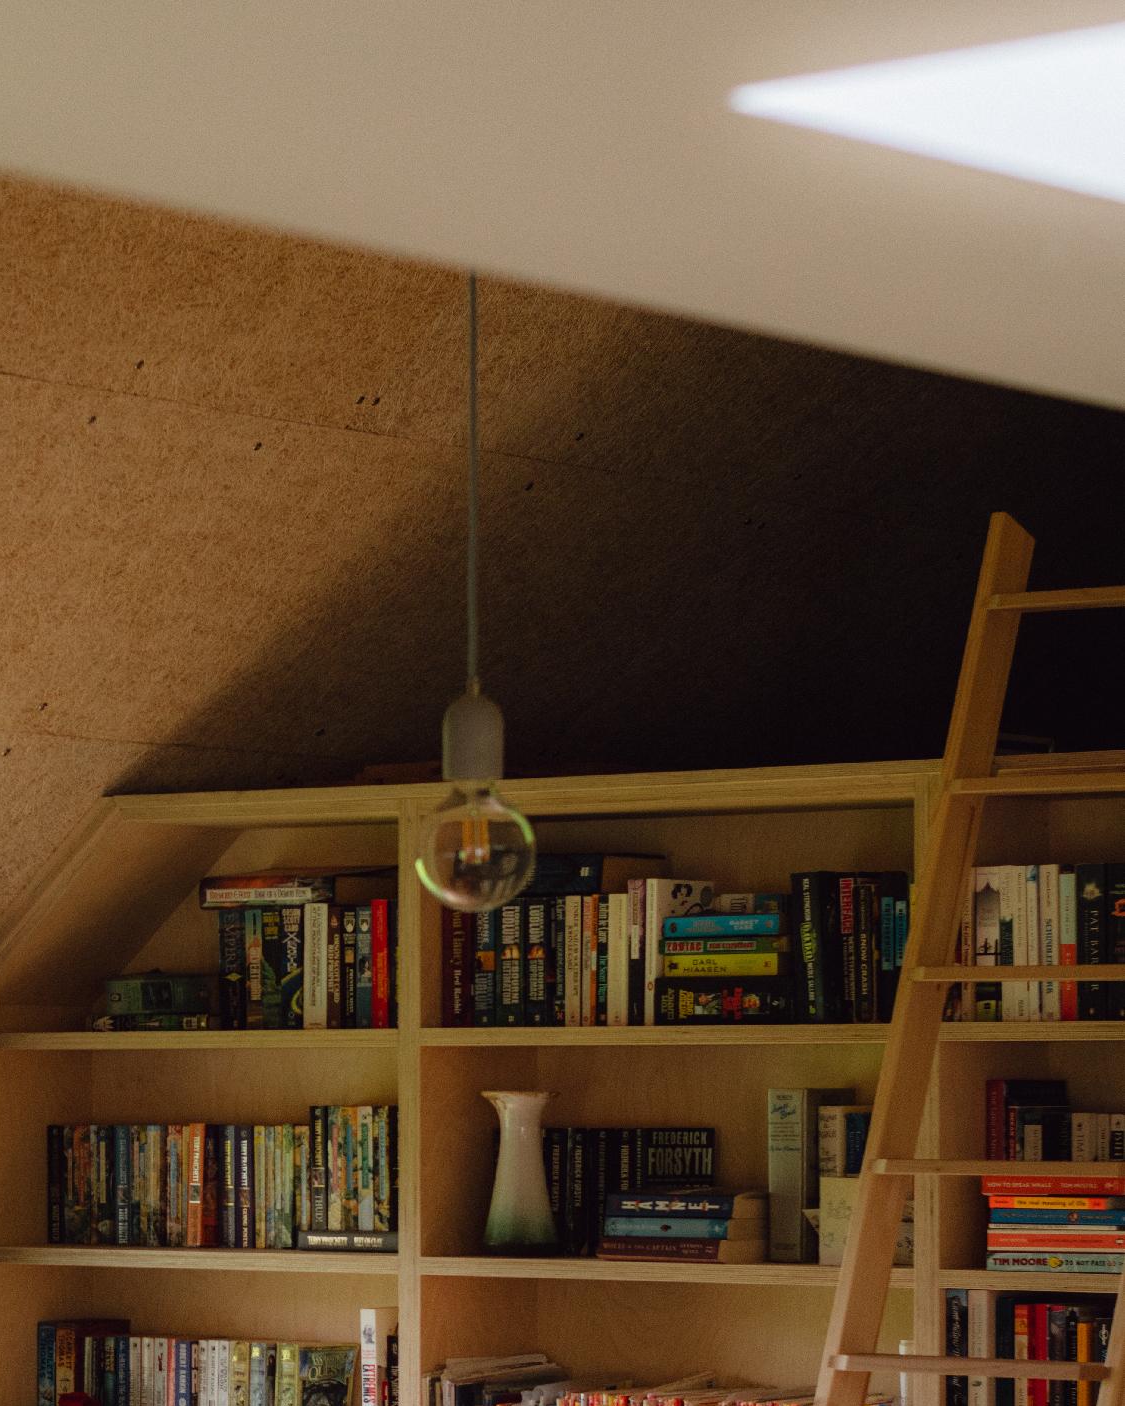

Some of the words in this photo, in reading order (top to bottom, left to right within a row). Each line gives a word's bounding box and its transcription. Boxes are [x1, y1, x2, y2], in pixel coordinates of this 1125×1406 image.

[841, 879, 853, 933] INTERFACE
[501, 906, 515, 945] LUDLUM
[528, 905, 540, 944] LUDLUM
[1090, 909, 1099, 932] PAT
[682, 966, 727, 974] HIAASEN
[652, 1130, 707, 1145] FREDERICK
[647, 1147, 713, 1176] FORSYTH
[314, 1193, 324, 1223] THUD!
[620, 1199, 721, 1213] HAMNET
[992, 1257, 1011, 1267] TIM
[1011, 1257, 1048, 1267] MOORE
